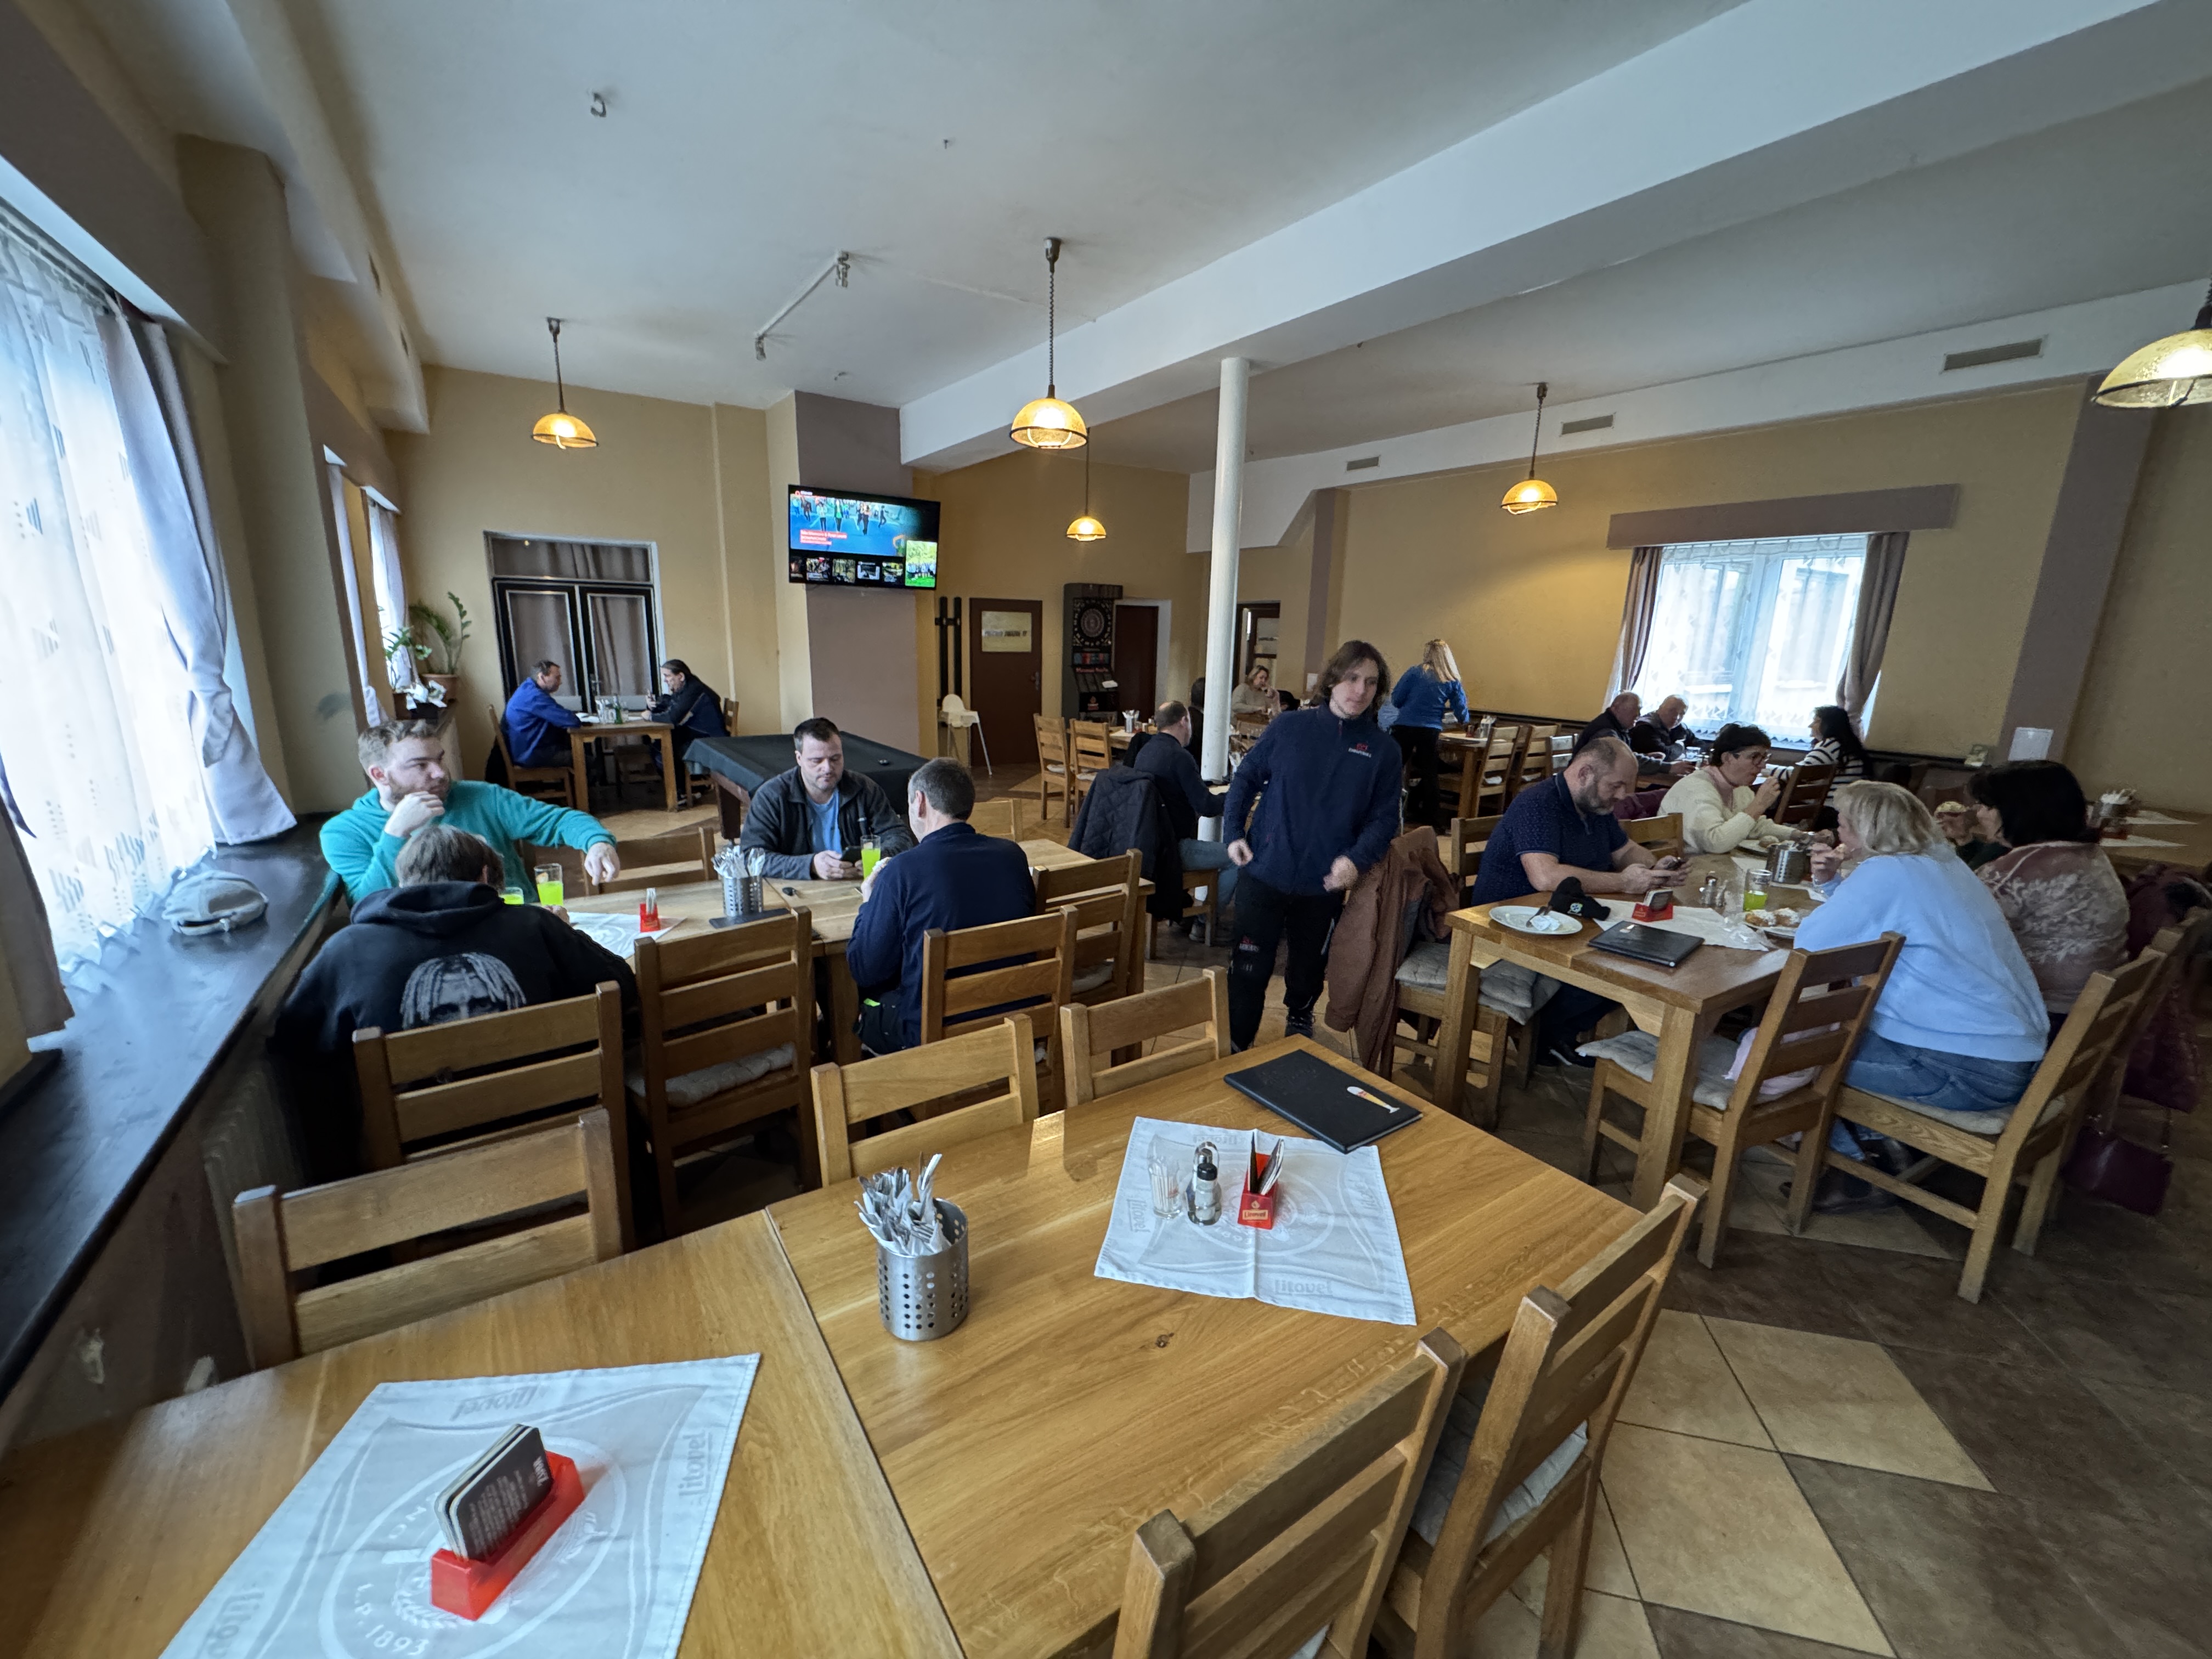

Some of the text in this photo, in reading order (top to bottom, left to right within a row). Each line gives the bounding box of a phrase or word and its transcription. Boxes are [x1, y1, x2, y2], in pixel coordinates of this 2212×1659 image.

[1274, 1279, 1333, 1297] Litovel
[449, 1385, 538, 1422] Litovel
[678, 1431, 713, 1497] Litovel
[365, 1624, 430, 1656] 1893
